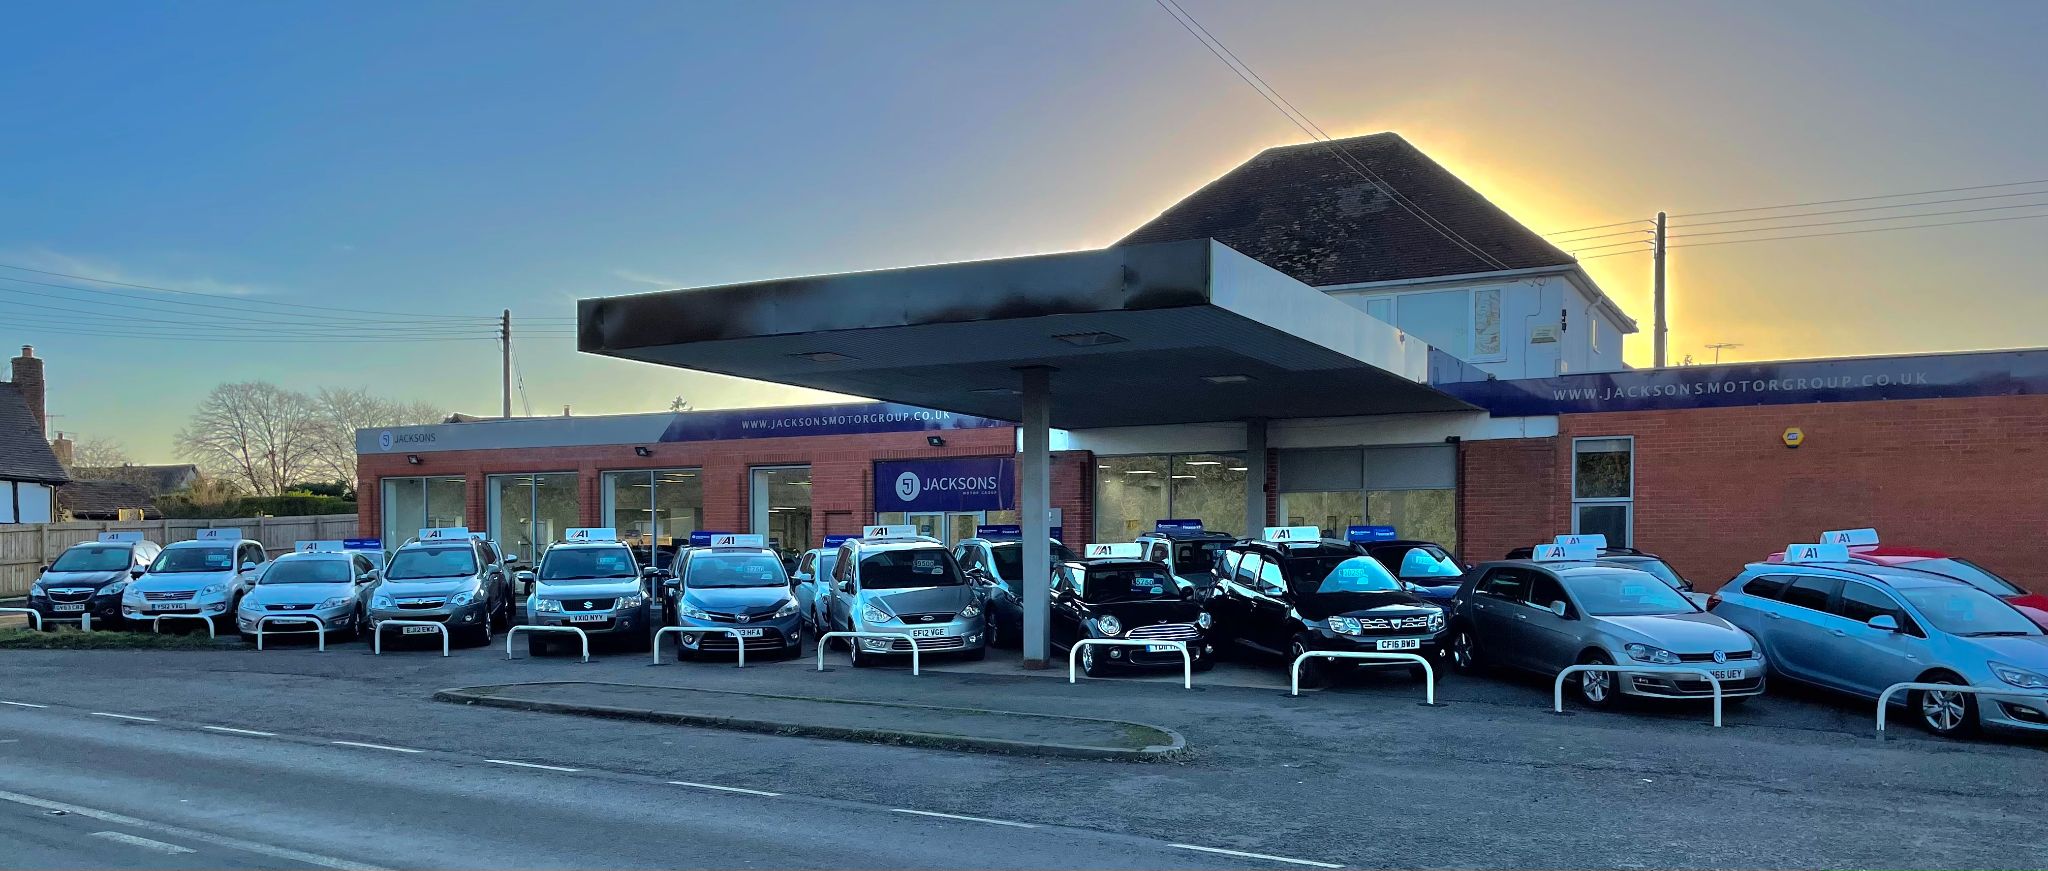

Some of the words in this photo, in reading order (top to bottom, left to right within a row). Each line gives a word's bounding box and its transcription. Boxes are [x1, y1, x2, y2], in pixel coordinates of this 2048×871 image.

[1553, 372, 1928, 401] WWW.JACKSONSMOTORGROUP.CO.UK
[742, 410, 950, 430] WWW.JACKSONSMOTORGROUP.CO.UK
[395, 433, 436, 444] JACKSONS
[923, 477, 997, 491] JACKSONS
[875, 527, 888, 536] A1
[1277, 529, 1291, 539] A1
[1098, 545, 1112, 555] A1
[913, 629, 929, 637] EF12
[931, 628, 945, 636] VGE
[1382, 640, 1400, 649] CF16
